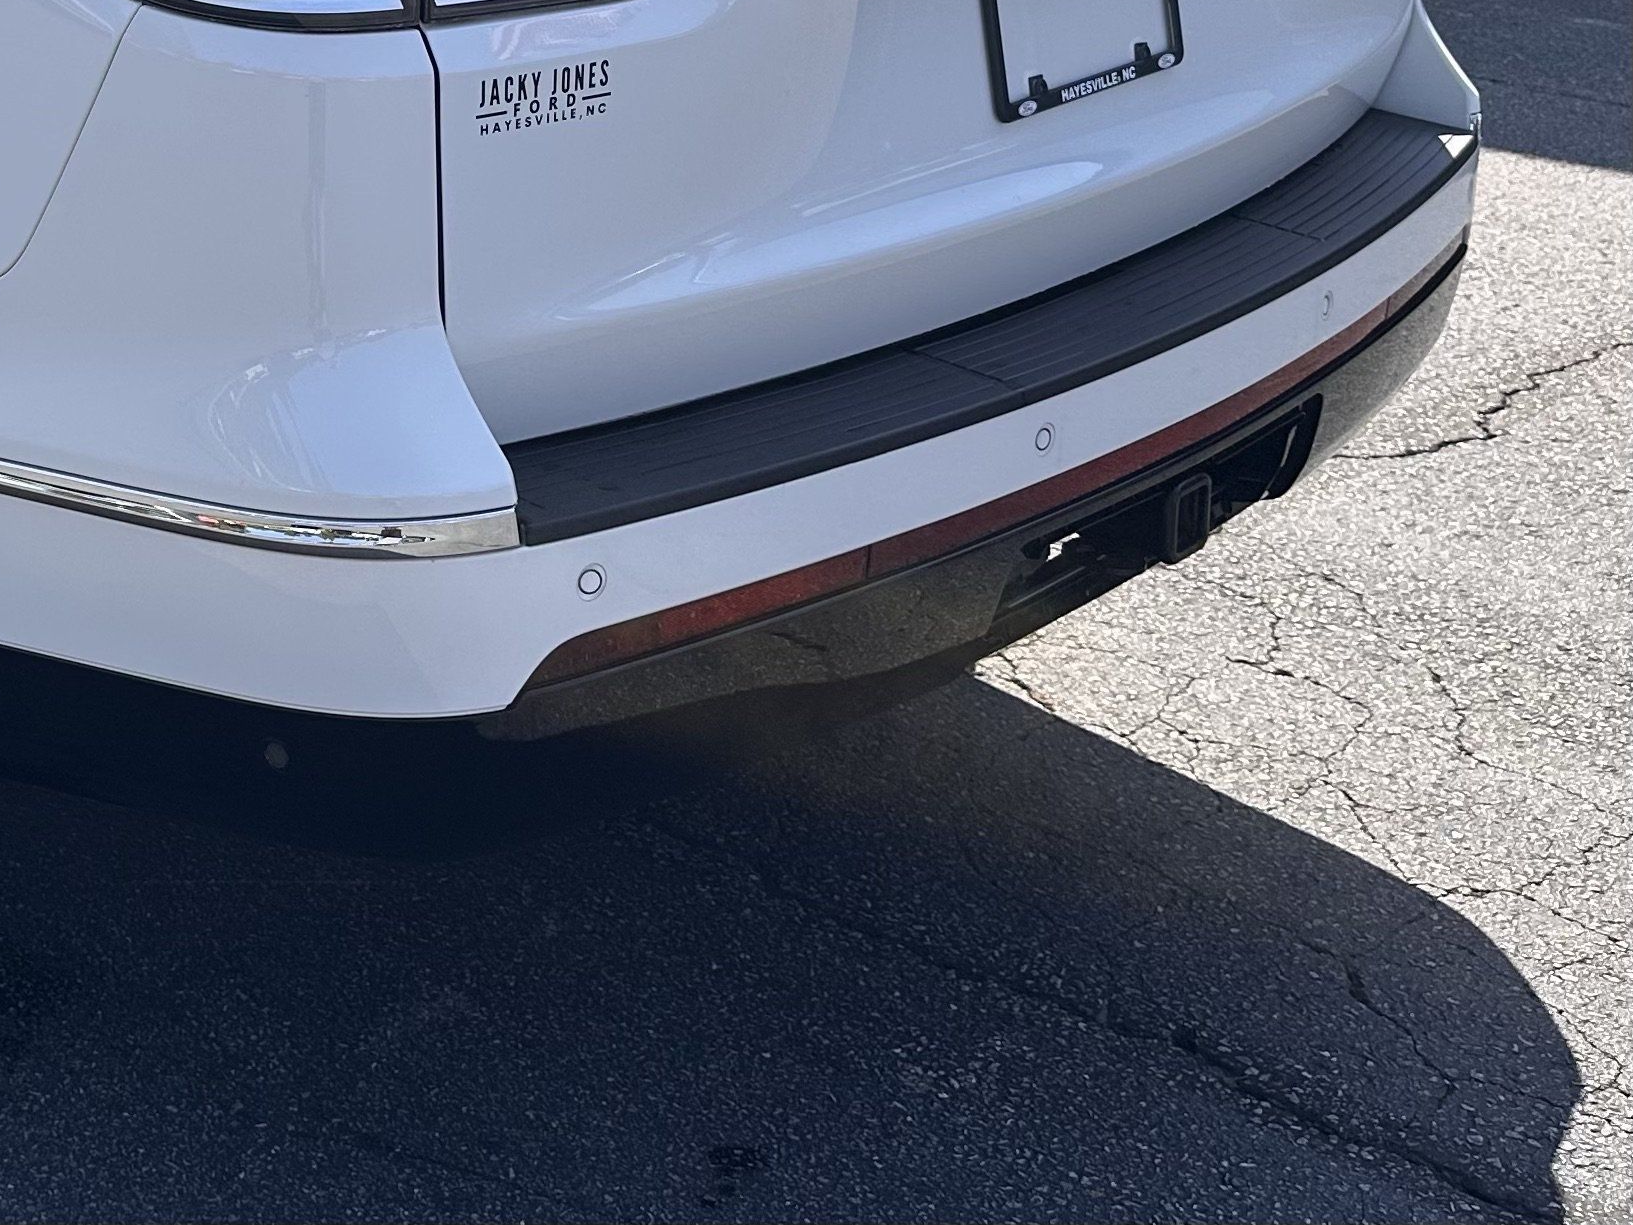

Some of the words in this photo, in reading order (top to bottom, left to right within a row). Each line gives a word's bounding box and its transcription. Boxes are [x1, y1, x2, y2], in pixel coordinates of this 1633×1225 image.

[479, 71, 542, 108] JACKY
[551, 59, 610, 95] JONES
[1122, 66, 1136, 81] NC
[513, 93, 576, 117] FORD
